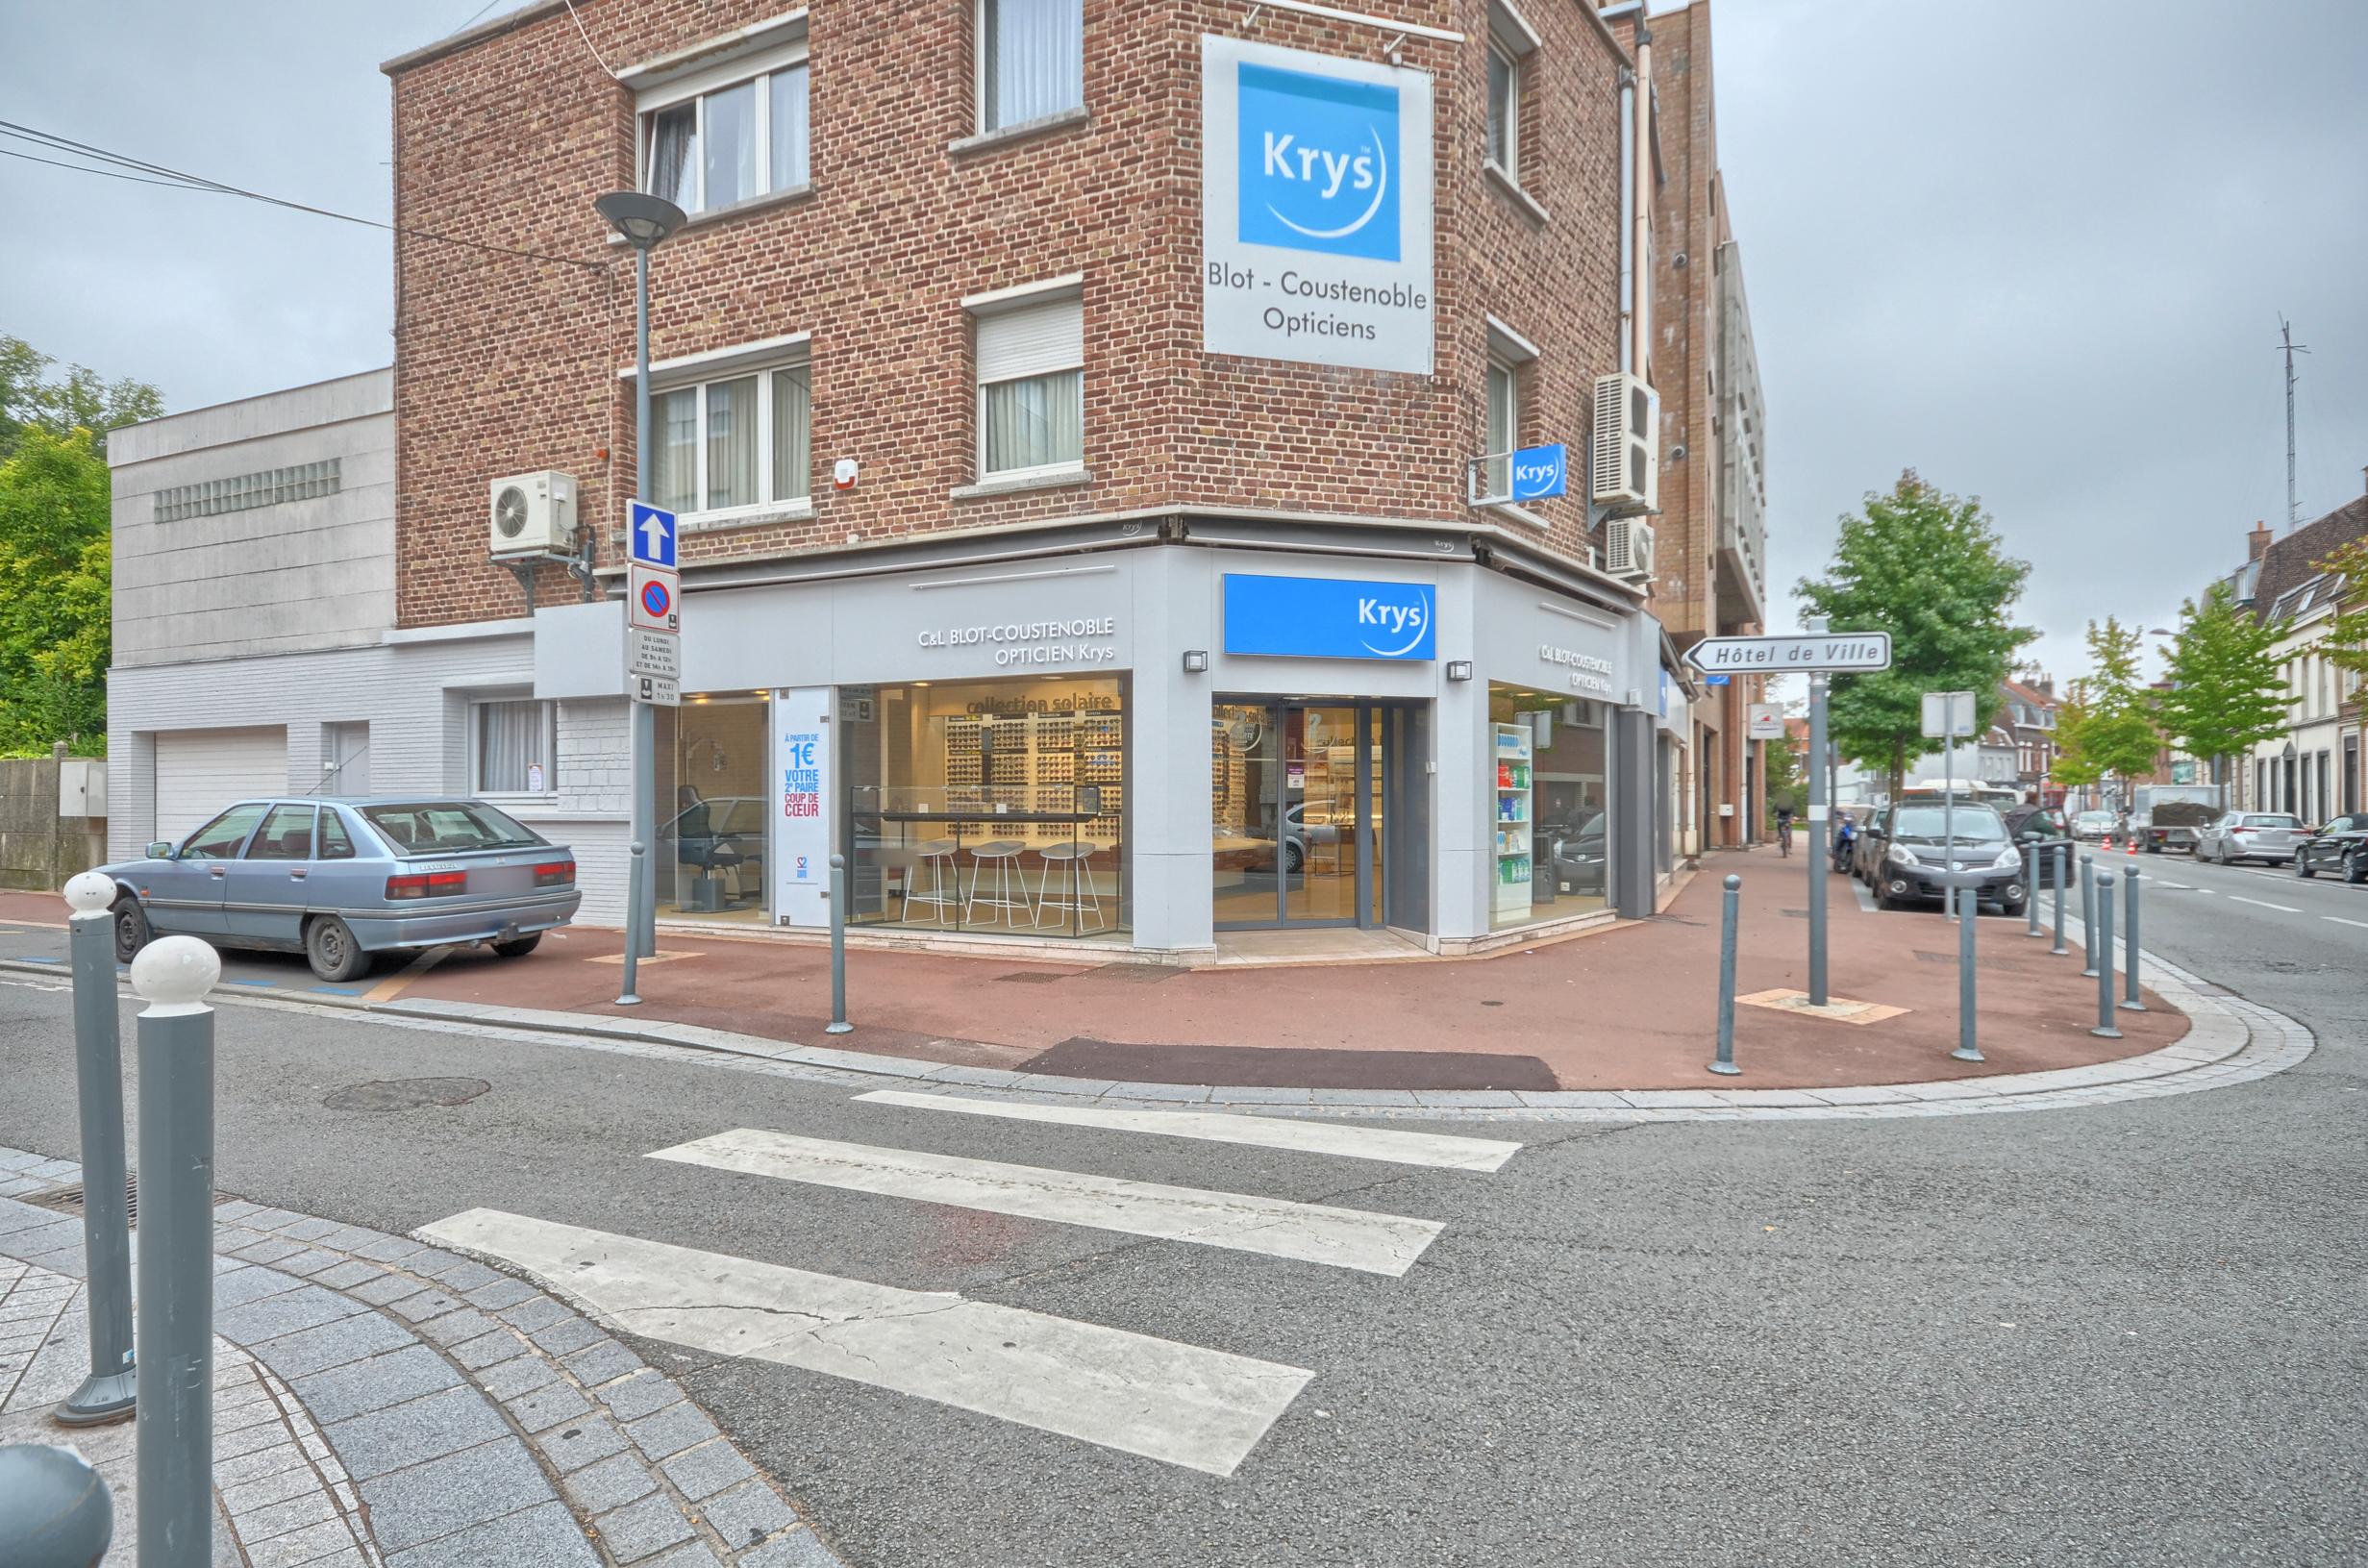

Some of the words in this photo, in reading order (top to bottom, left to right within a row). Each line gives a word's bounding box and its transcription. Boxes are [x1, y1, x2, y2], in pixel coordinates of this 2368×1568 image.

[1264, 131, 1374, 199] Krys
[1209, 261, 1254, 289] Blot
[1281, 271, 1427, 310] Coustenoble
[1263, 307, 1376, 339] Opticiens
[1516, 463, 1555, 483] Krys
[1358, 598, 1421, 634] Krys
[918, 631, 945, 647] C&L
[950, 617, 1114, 645] BLOT-COUSTENOBLE
[995, 645, 1075, 665] OPTICIEN
[1079, 643, 1114, 663] Krys
[1716, 645, 1775, 663] Hôtel
[1788, 645, 1813, 661] de
[1826, 643, 1879, 660] Ville
[658, 683, 674, 691] MAXI
[966, 695, 1048, 713] collection
[1053, 692, 1112, 711] solaire
[790, 734, 810, 742] PARTIR
[811, 734, 819, 742] DE
[790, 742, 814, 769] 1€
[785, 769, 819, 782] VOTRE
[795, 783, 819, 792] PAIRE
[785, 793, 806, 803] COUP
[809, 793, 819, 803] DE
[785, 804, 819, 816] CŒUR
